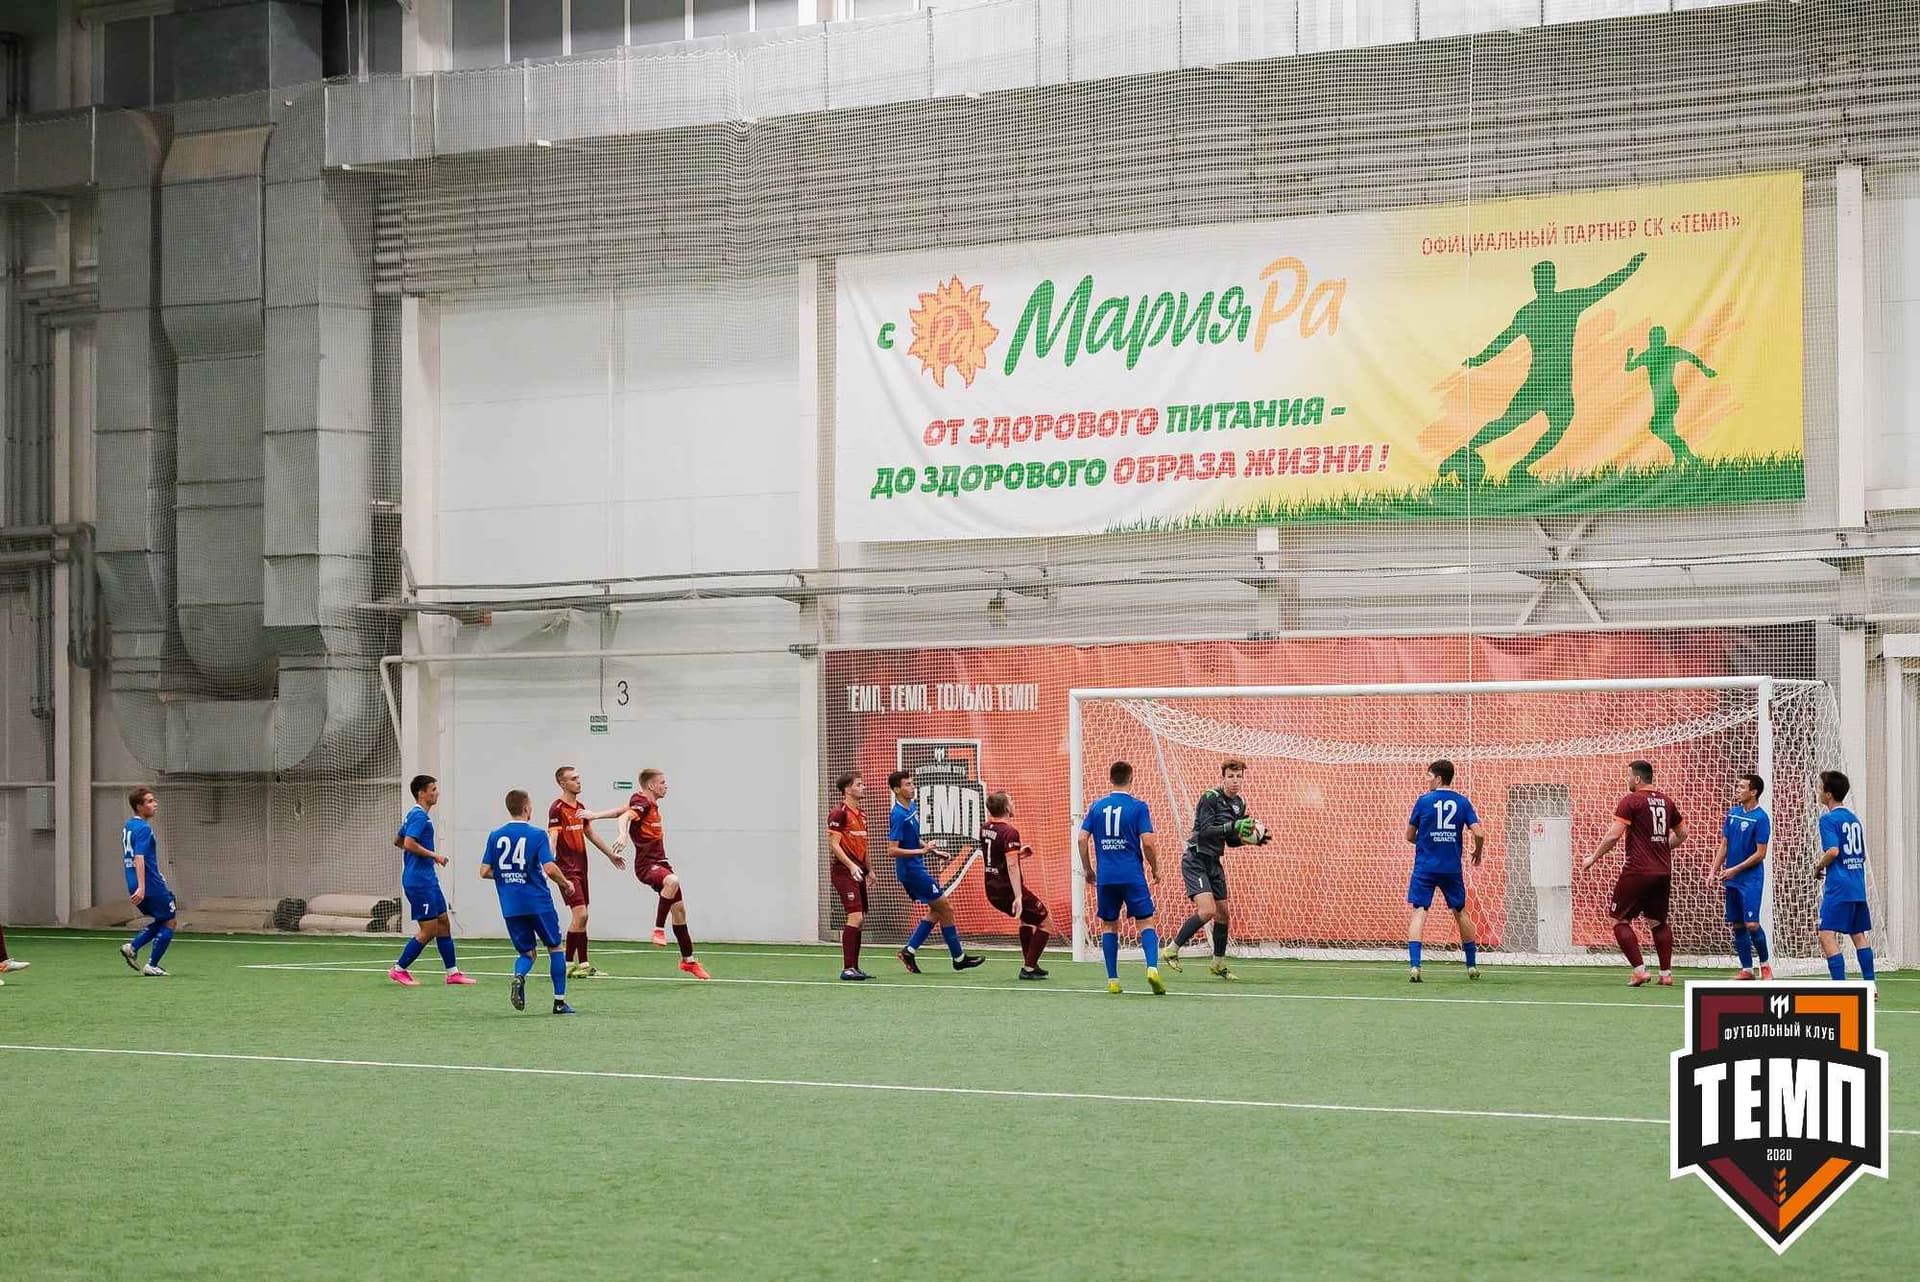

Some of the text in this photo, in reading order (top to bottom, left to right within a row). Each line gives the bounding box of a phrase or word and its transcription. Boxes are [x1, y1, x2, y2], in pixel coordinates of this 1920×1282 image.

[1422, 211, 1741, 257] ОФИЦИАЛЬНЫЙ ПАРТНЕР СК «ТЕМП»
[923, 419, 964, 446] ОТ
[969, 408, 1158, 449] ЗДОРОВОГО
[1167, 397, 1324, 434] ПИТАНИЯ
[870, 468, 915, 499] ДО
[921, 459, 1107, 496] ЗДОРОВОГО
[1114, 451, 1236, 485] ОБРАЗА
[617, 680, 629, 706] 3
[890, 684, 932, 713] ТЕМП,
[936, 683, 993, 711] ТОЛЬКО
[997, 683, 1038, 711] ТЕМП!
[919, 785, 980, 840] ЕМП
[1102, 805, 1122, 837] 11
[1433, 799, 1457, 830] 12
[1649, 806, 1667, 836] 13
[496, 836, 527, 870] 24
[1842, 821, 1862, 855] 30
[1197, 877, 1203, 889] 1
[422, 904, 429, 915] 7
